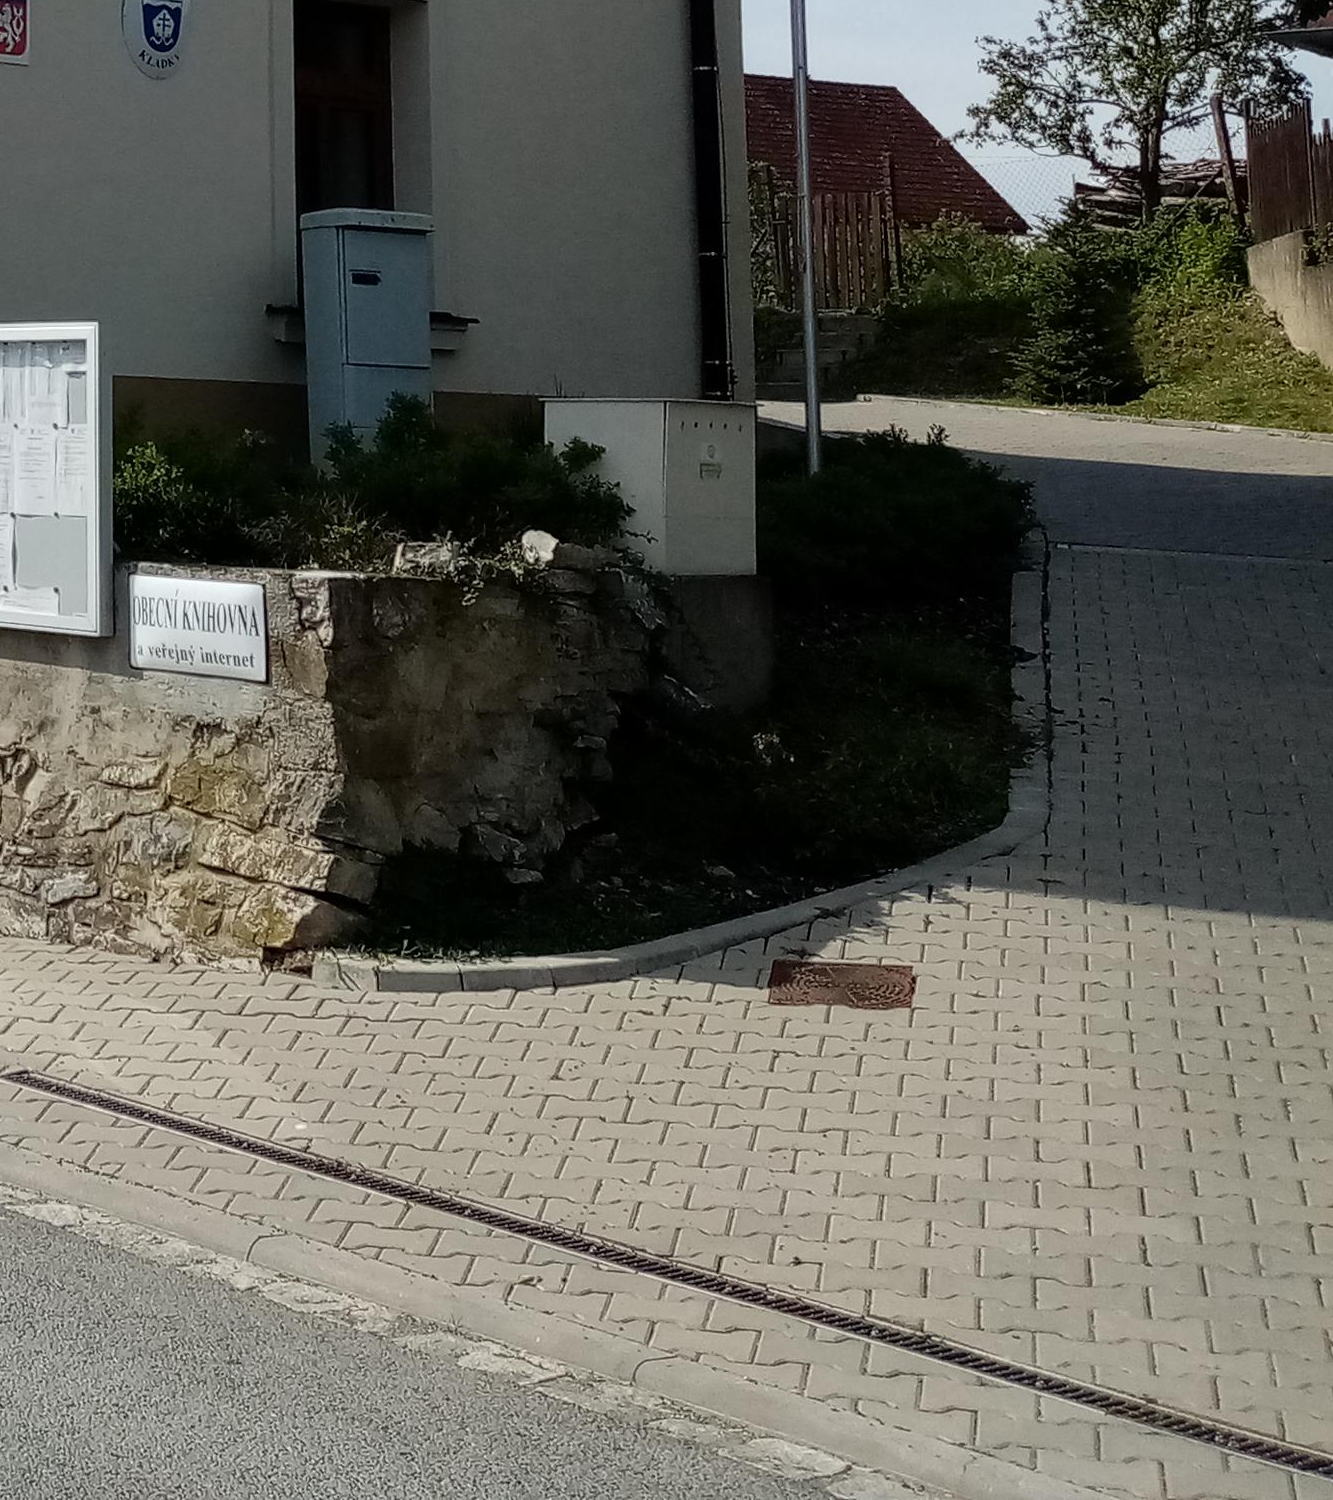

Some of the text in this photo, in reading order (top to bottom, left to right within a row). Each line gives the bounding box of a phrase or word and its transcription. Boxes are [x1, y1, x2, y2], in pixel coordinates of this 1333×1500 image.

[133, 589, 260, 637] OBECNÍ KNIHOVNA
[137, 644, 255, 668] a veřejný internet
